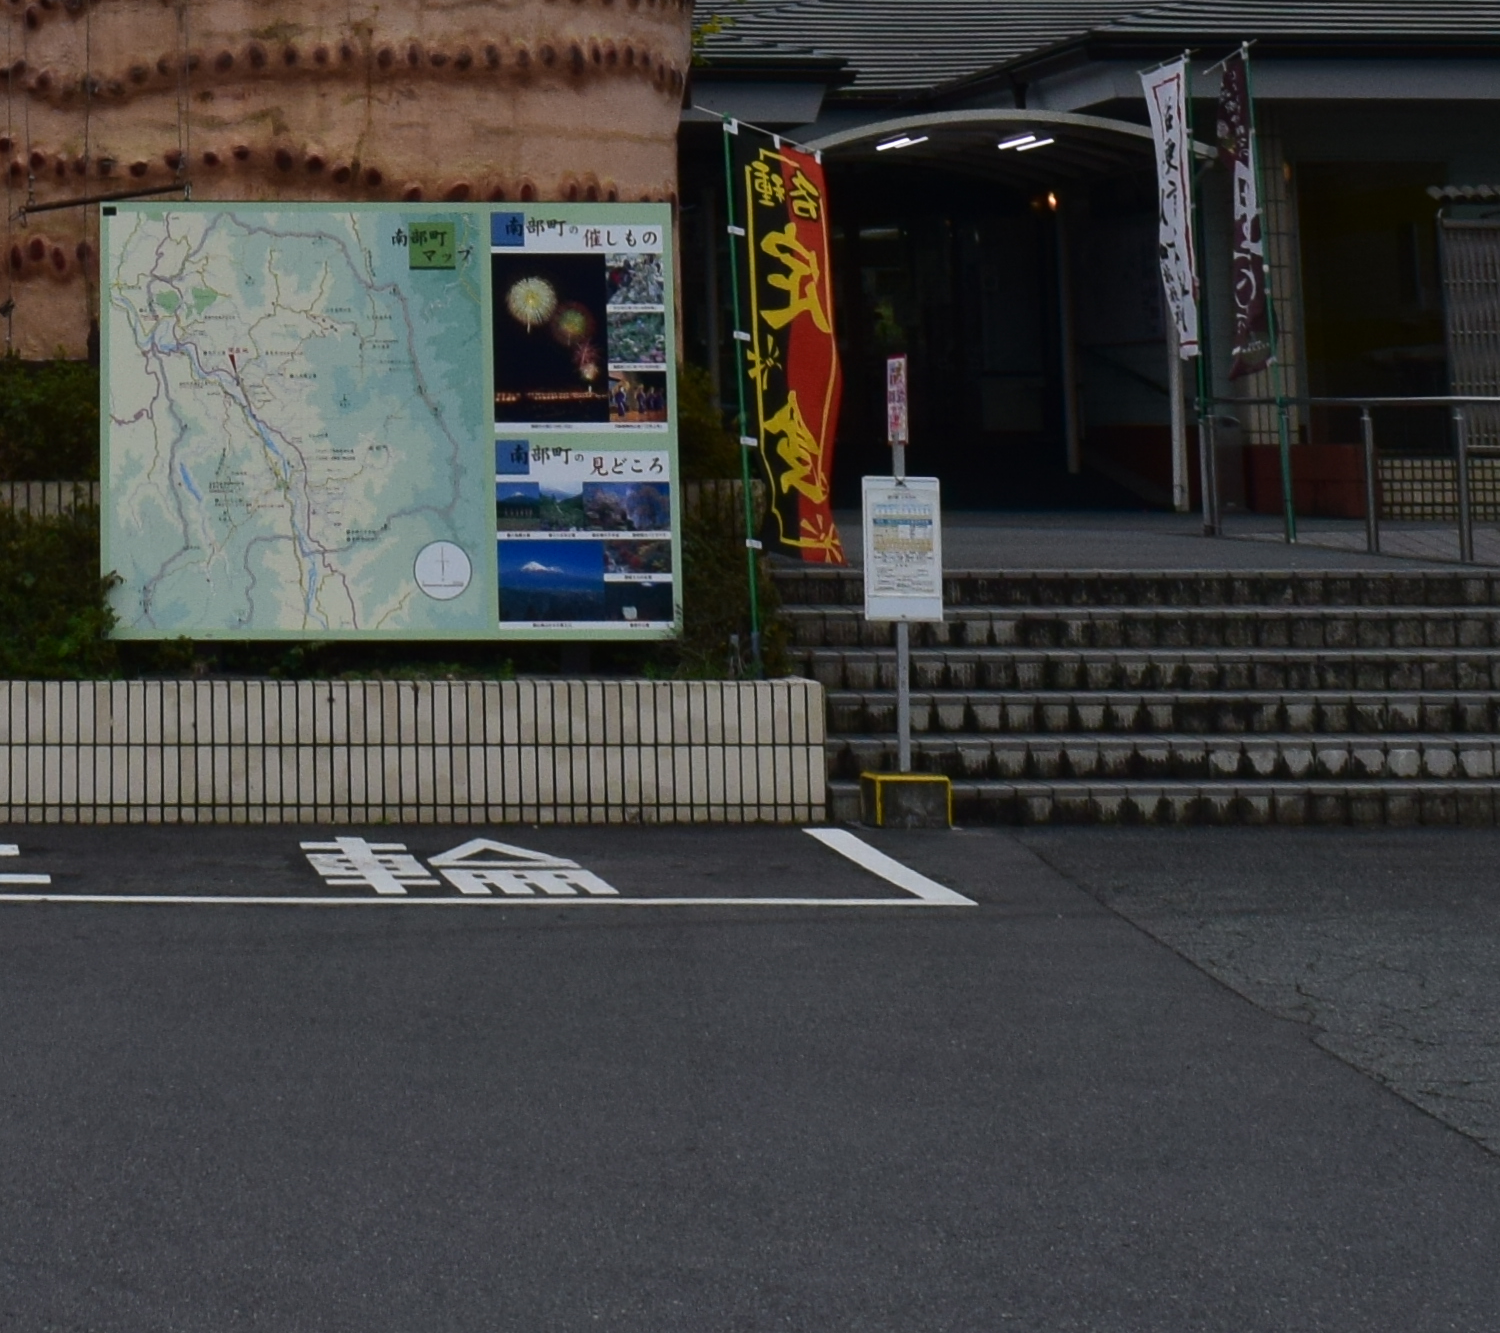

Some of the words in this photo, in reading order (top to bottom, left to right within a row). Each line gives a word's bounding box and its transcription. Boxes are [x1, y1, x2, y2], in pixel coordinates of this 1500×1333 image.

[391, 228, 447, 247] 南部町
[421, 245, 474, 263] マップ
[510, 444, 664, 476] 南部町の見どころ
